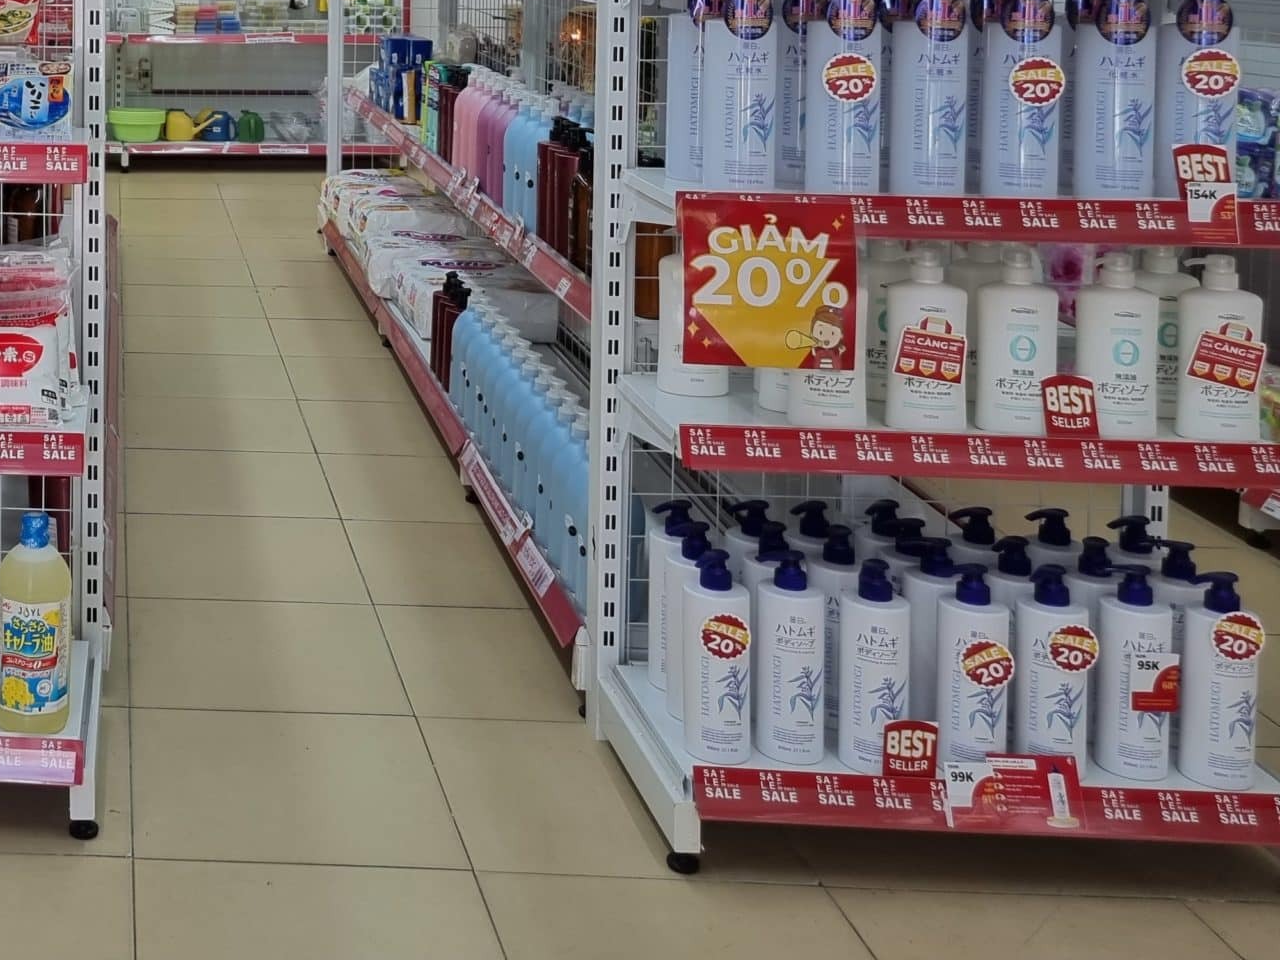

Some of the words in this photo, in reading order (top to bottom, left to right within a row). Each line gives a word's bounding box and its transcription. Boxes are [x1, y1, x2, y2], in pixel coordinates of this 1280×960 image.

[830, 66, 867, 76] SALE
[1189, 62, 1232, 72] SALE
[1018, 70, 1057, 80] SALE
[46, 161, 78, 171] SALE
[1178, 154, 1227, 182] BEST
[1188, 190, 1217, 200] 154K
[908, 214, 944, 225] SALE
[1138, 219, 1176, 230] SALE
[708, 214, 830, 258] GIẢM
[690, 256, 849, 310] 20%
[917, 337, 948, 349] CÀNG
[803, 374, 855, 387] ボディソープ
[1098, 382, 1150, 395] ボディソープ
[1052, 416, 1090, 428] SELLER
[43, 450, 75, 460] SALE
[690, 445, 726, 456] SALE
[1198, 462, 1236, 473] SALE
[1137, 660, 1160, 671] 95K
[951, 771, 974, 782] 99K
[705, 788, 742, 800] SALE
[1219, 814, 1258, 825] SALE
